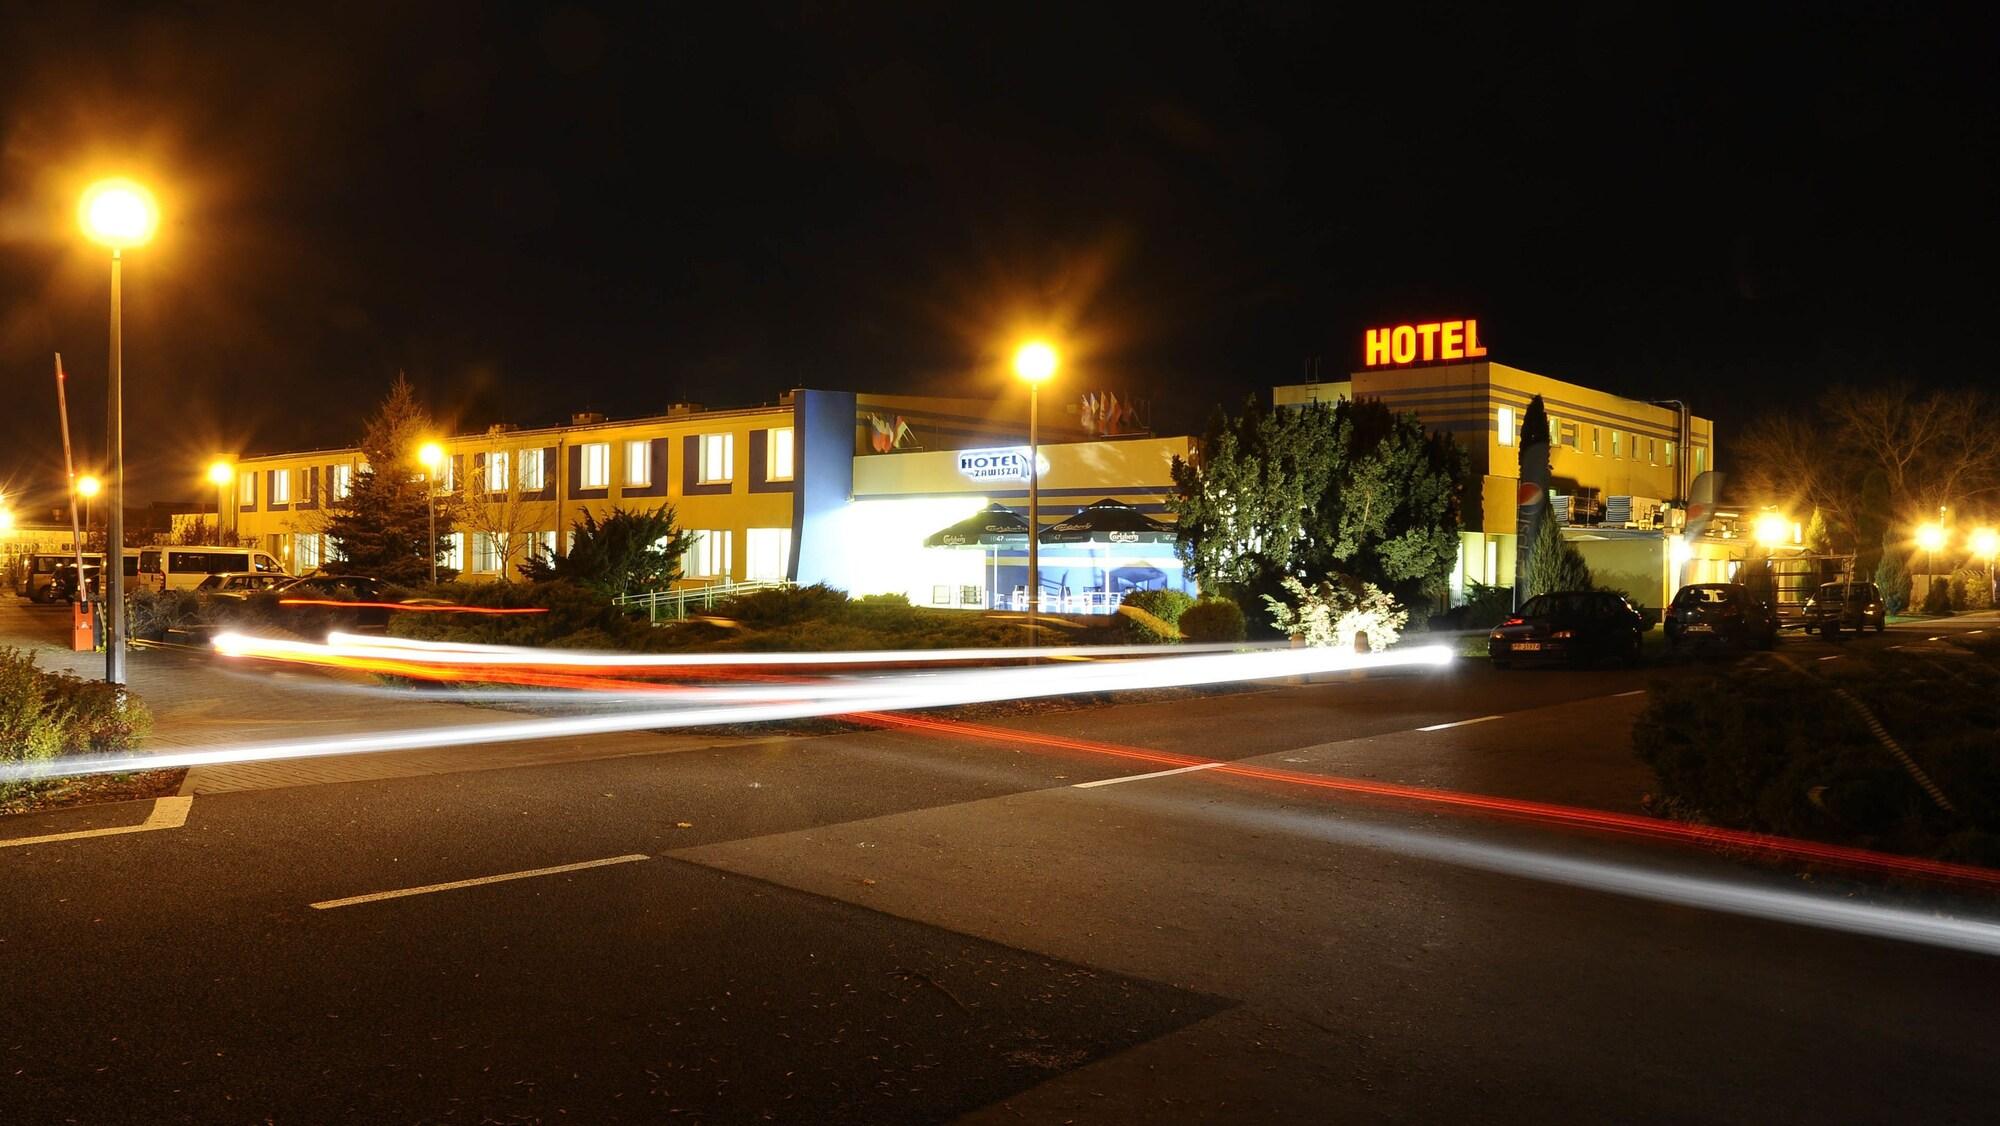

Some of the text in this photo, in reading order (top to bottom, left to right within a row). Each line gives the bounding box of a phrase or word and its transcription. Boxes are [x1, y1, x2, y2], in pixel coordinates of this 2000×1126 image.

[1366, 319, 1487, 366] HOTEL
[961, 455, 1019, 469] HOTEL
[974, 467, 1019, 477] ZAWISZA
[1109, 531, 1139, 543] Carlsberg
